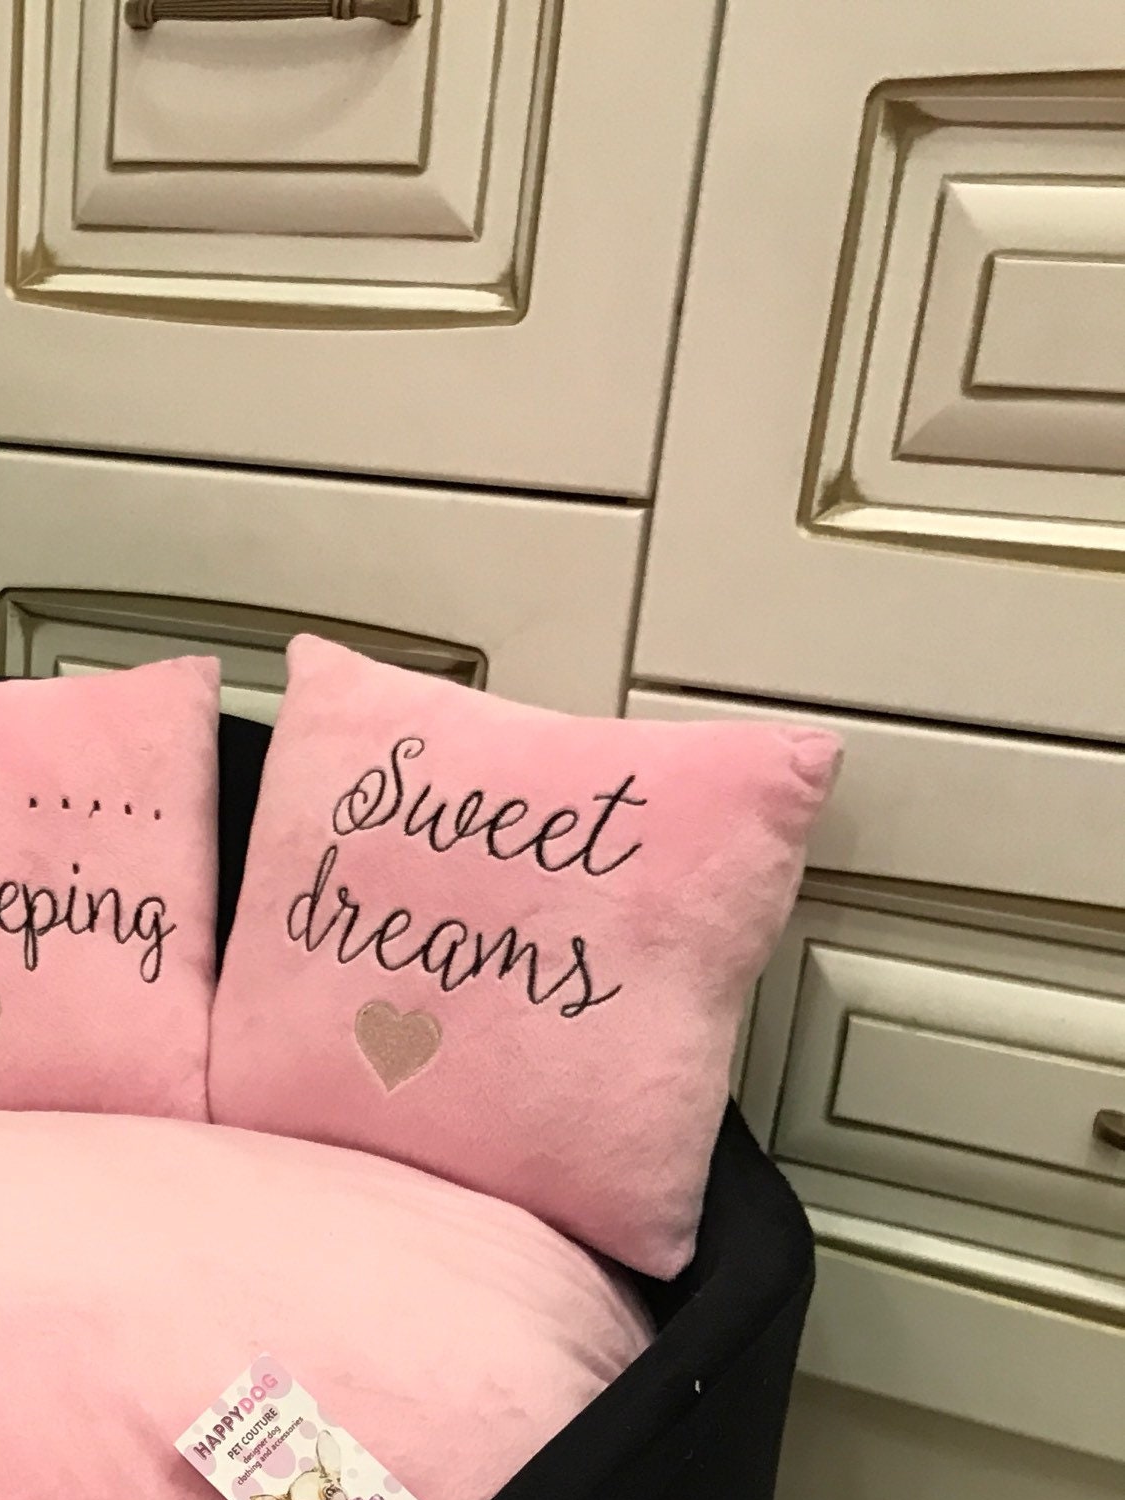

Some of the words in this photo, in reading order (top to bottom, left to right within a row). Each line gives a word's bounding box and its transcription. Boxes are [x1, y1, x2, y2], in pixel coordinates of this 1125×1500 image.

[333, 736, 647, 876] Sweet
[286, 844, 622, 1018] dreams
[227, 1443, 243, 1460] PET
[241, 1408, 278, 1445] COUTURE
[237, 1461, 263, 1486] clothing
[260, 1449, 273, 1462] and
[271, 1416, 304, 1450] accessories
[243, 1438, 268, 1464] designer
[267, 1425, 282, 1439] dog
